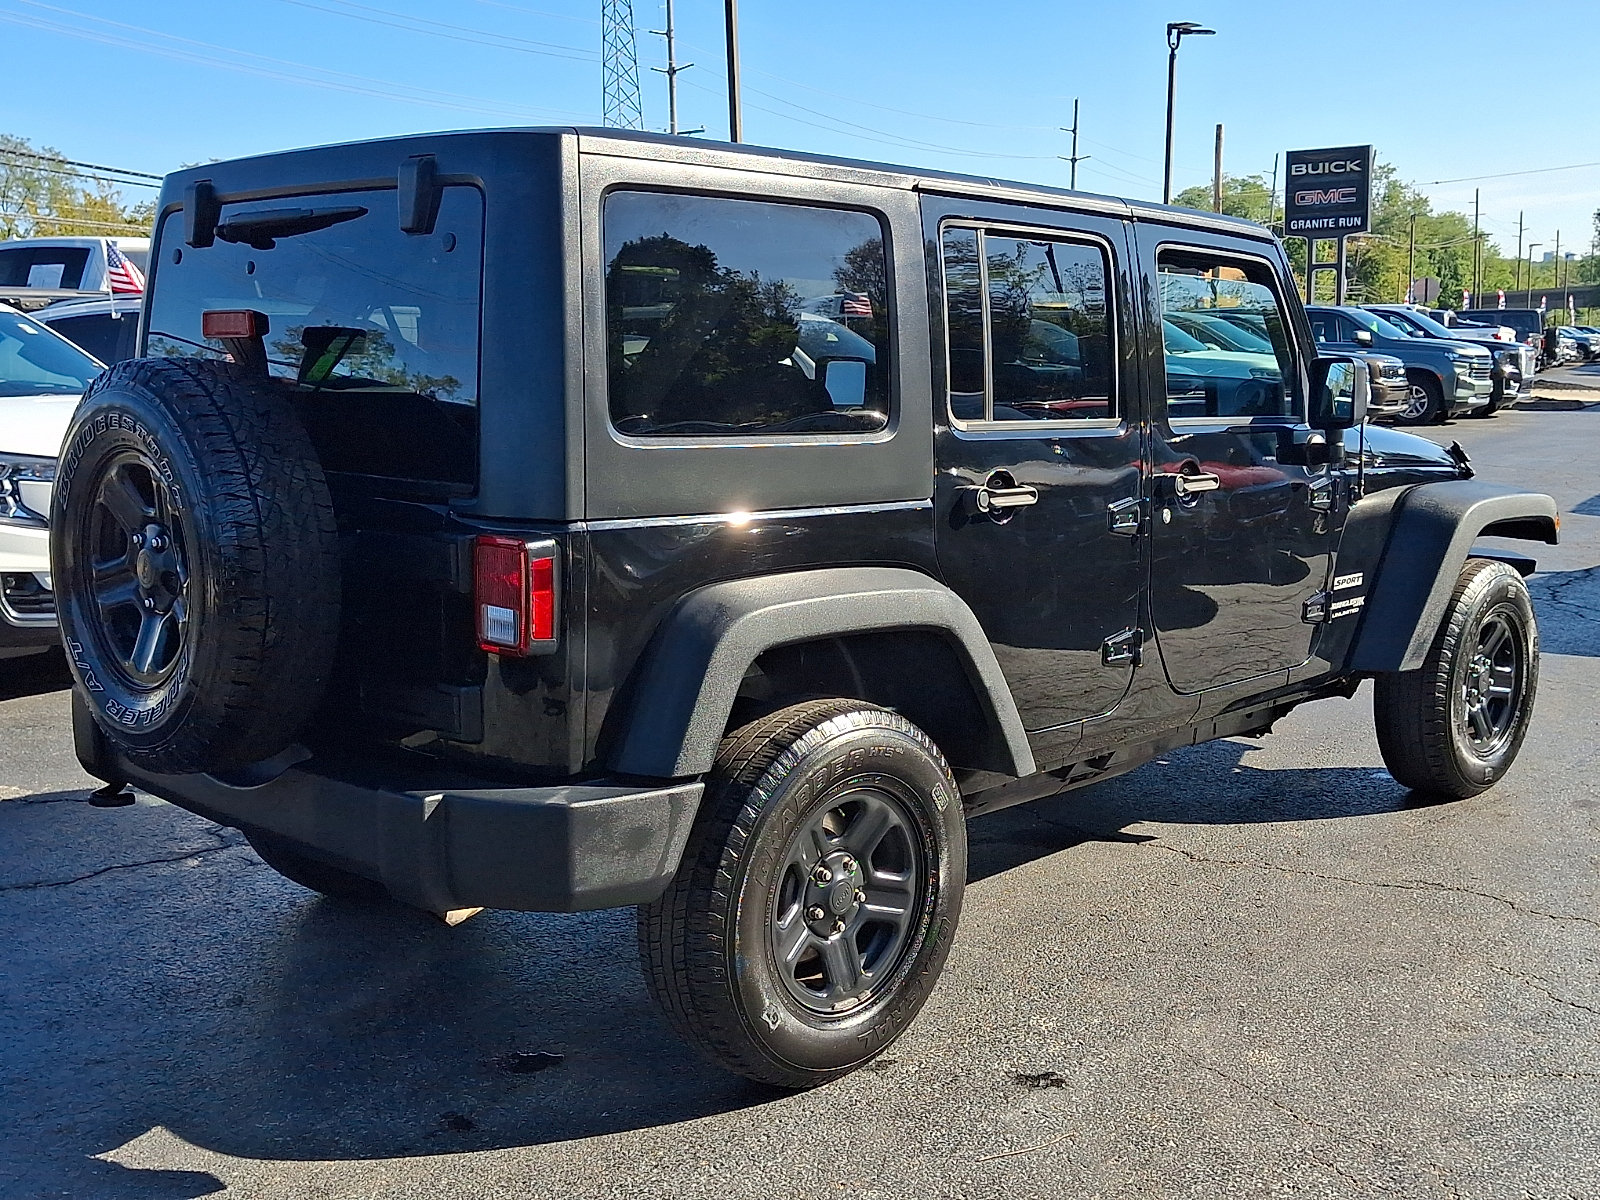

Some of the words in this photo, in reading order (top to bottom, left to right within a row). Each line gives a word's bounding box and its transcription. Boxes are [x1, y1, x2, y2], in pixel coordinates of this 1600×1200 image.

[1291, 160, 1362, 176] BUICK
[1295, 187, 1357, 206] GMC
[1290, 217, 1336, 230] GRANITE
[1338, 216, 1361, 227] RUN
[1335, 576, 1362, 587] SPORT
